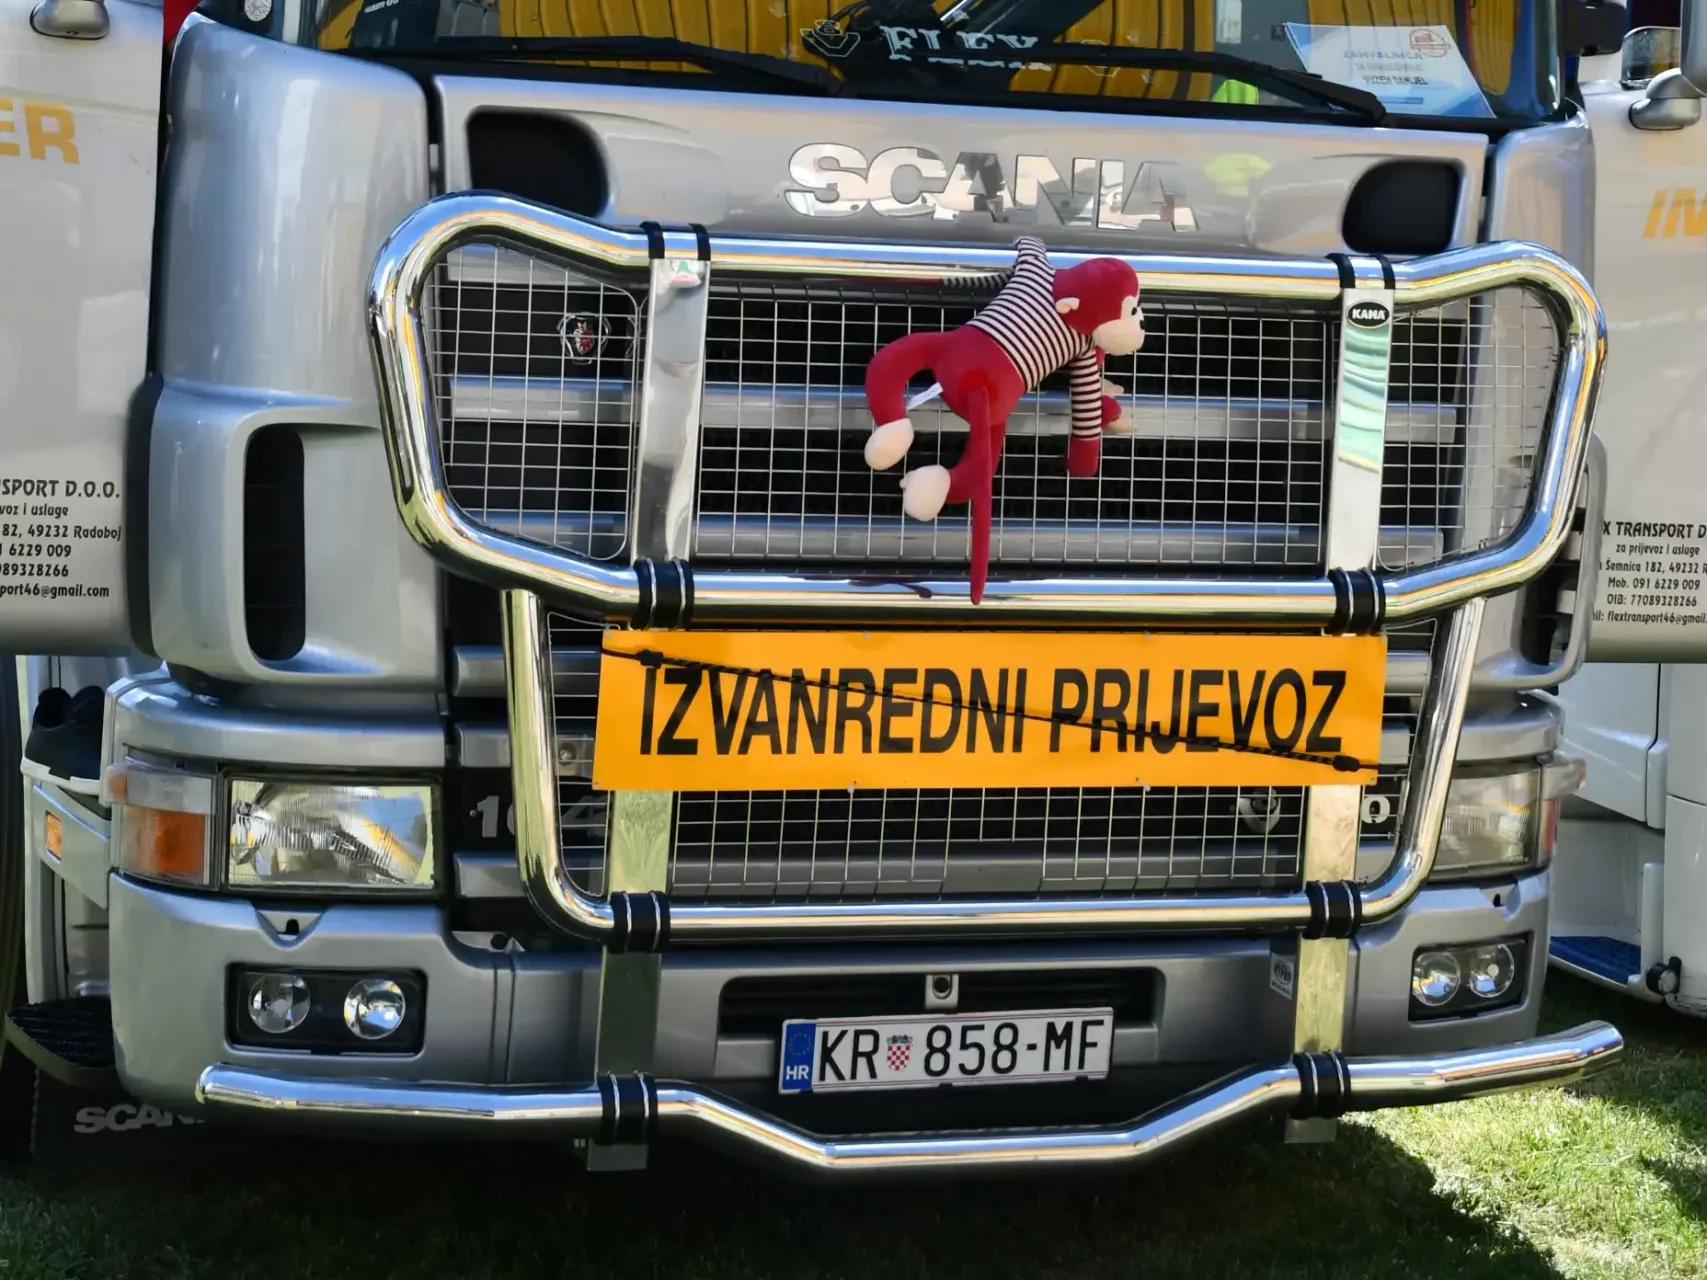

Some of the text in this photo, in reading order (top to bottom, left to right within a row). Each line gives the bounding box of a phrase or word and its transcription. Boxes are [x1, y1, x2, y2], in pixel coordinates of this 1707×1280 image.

[784, 142, 1199, 232] SCANIA
[0, 478, 121, 499] SPORT D.O.O.
[23, 502, 27, 516] i
[31, 503, 69, 519] usluge
[28, 524, 69, 538] 49232
[74, 525, 122, 541] Radoboj
[1616, 521, 1694, 539] TRANSPORT
[9, 543, 42, 557] 6229
[47, 544, 72, 558] 009
[1616, 544, 1626, 553] za
[1629, 542, 1664, 556] prijevoz
[1672, 544, 1700, 558] usluge
[0, 563, 69, 577] 89328266
[1605, 557, 1641, 572] Šemnica
[1669, 562, 1699, 574] 49232
[1608, 577, 1701, 590] Mob. 091 6229 009
[1607, 593, 1698, 607] OIB: 77089328266
[640, 667, 1347, 755] IZVANREDNI PRIJEVOZ
[818, 1019, 1105, 1082] KR 858-MF
[785, 1066, 809, 1081] HR
